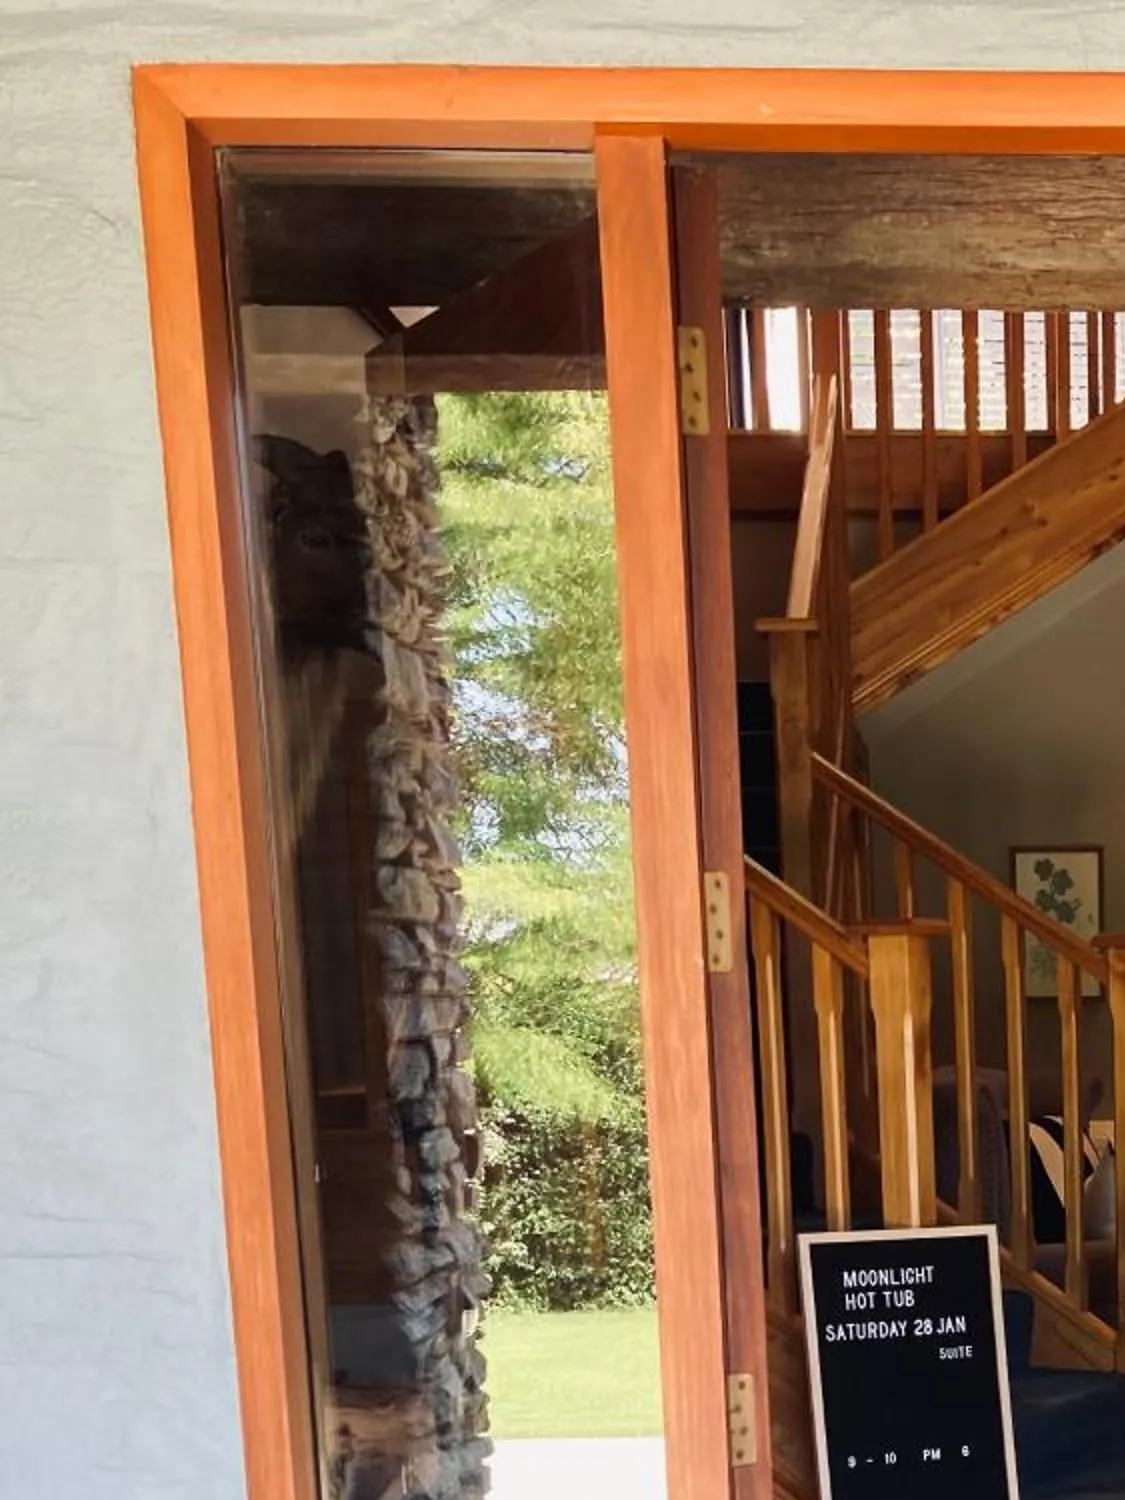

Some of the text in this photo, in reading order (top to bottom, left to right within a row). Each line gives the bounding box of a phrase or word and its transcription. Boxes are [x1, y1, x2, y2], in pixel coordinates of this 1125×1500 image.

[842, 1265, 935, 1288] MOONLIGHT
[844, 1289, 915, 1311] HOT TUB
[825, 1315, 967, 1342] SATURDAY 28 JAN
[939, 1345, 973, 1360] SUITE
[884, 1451, 897, 1465] 10
[922, 1447, 942, 1461] PM
